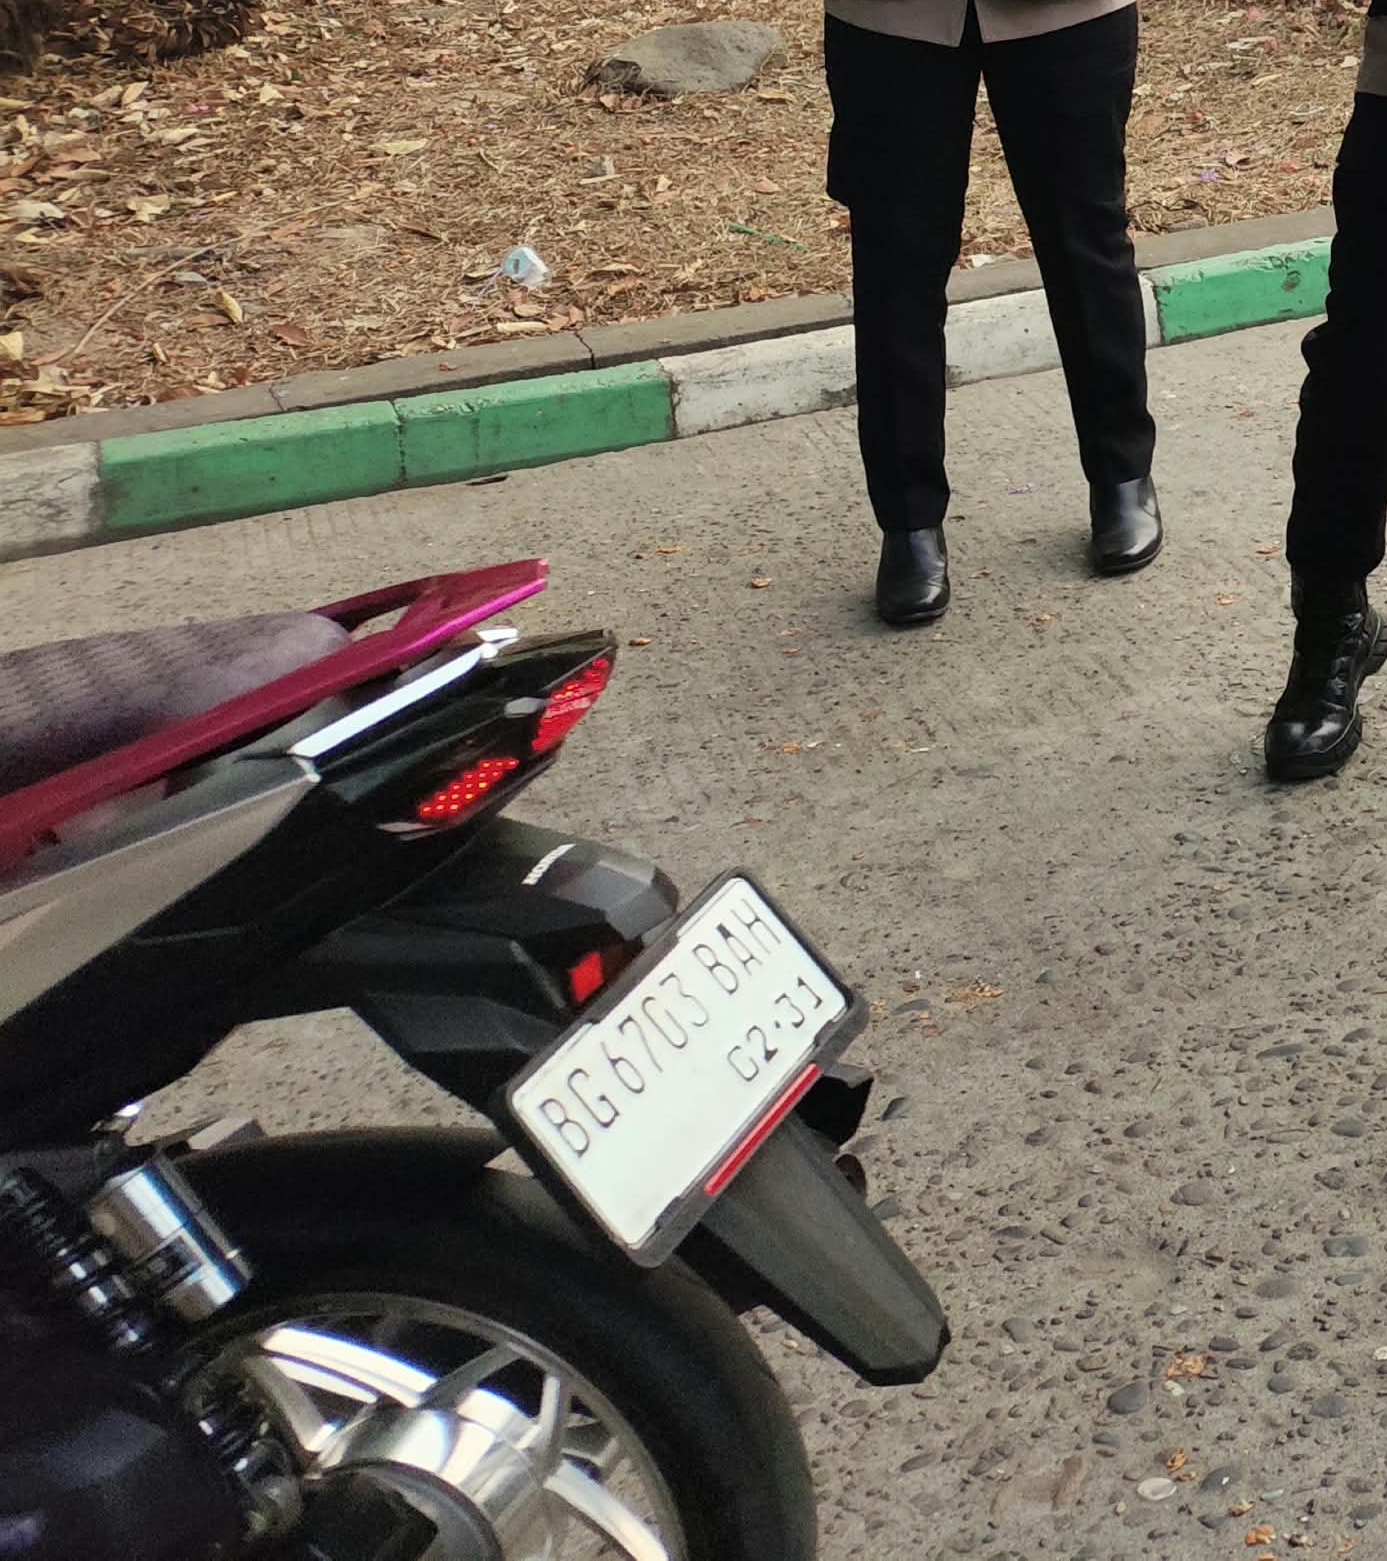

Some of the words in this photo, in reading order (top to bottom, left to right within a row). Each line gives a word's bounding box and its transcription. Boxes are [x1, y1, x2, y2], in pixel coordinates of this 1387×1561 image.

[538, 1067, 621, 1159] BG
[600, 971, 710, 1094] 6703
[691, 897, 782, 995] BAH
